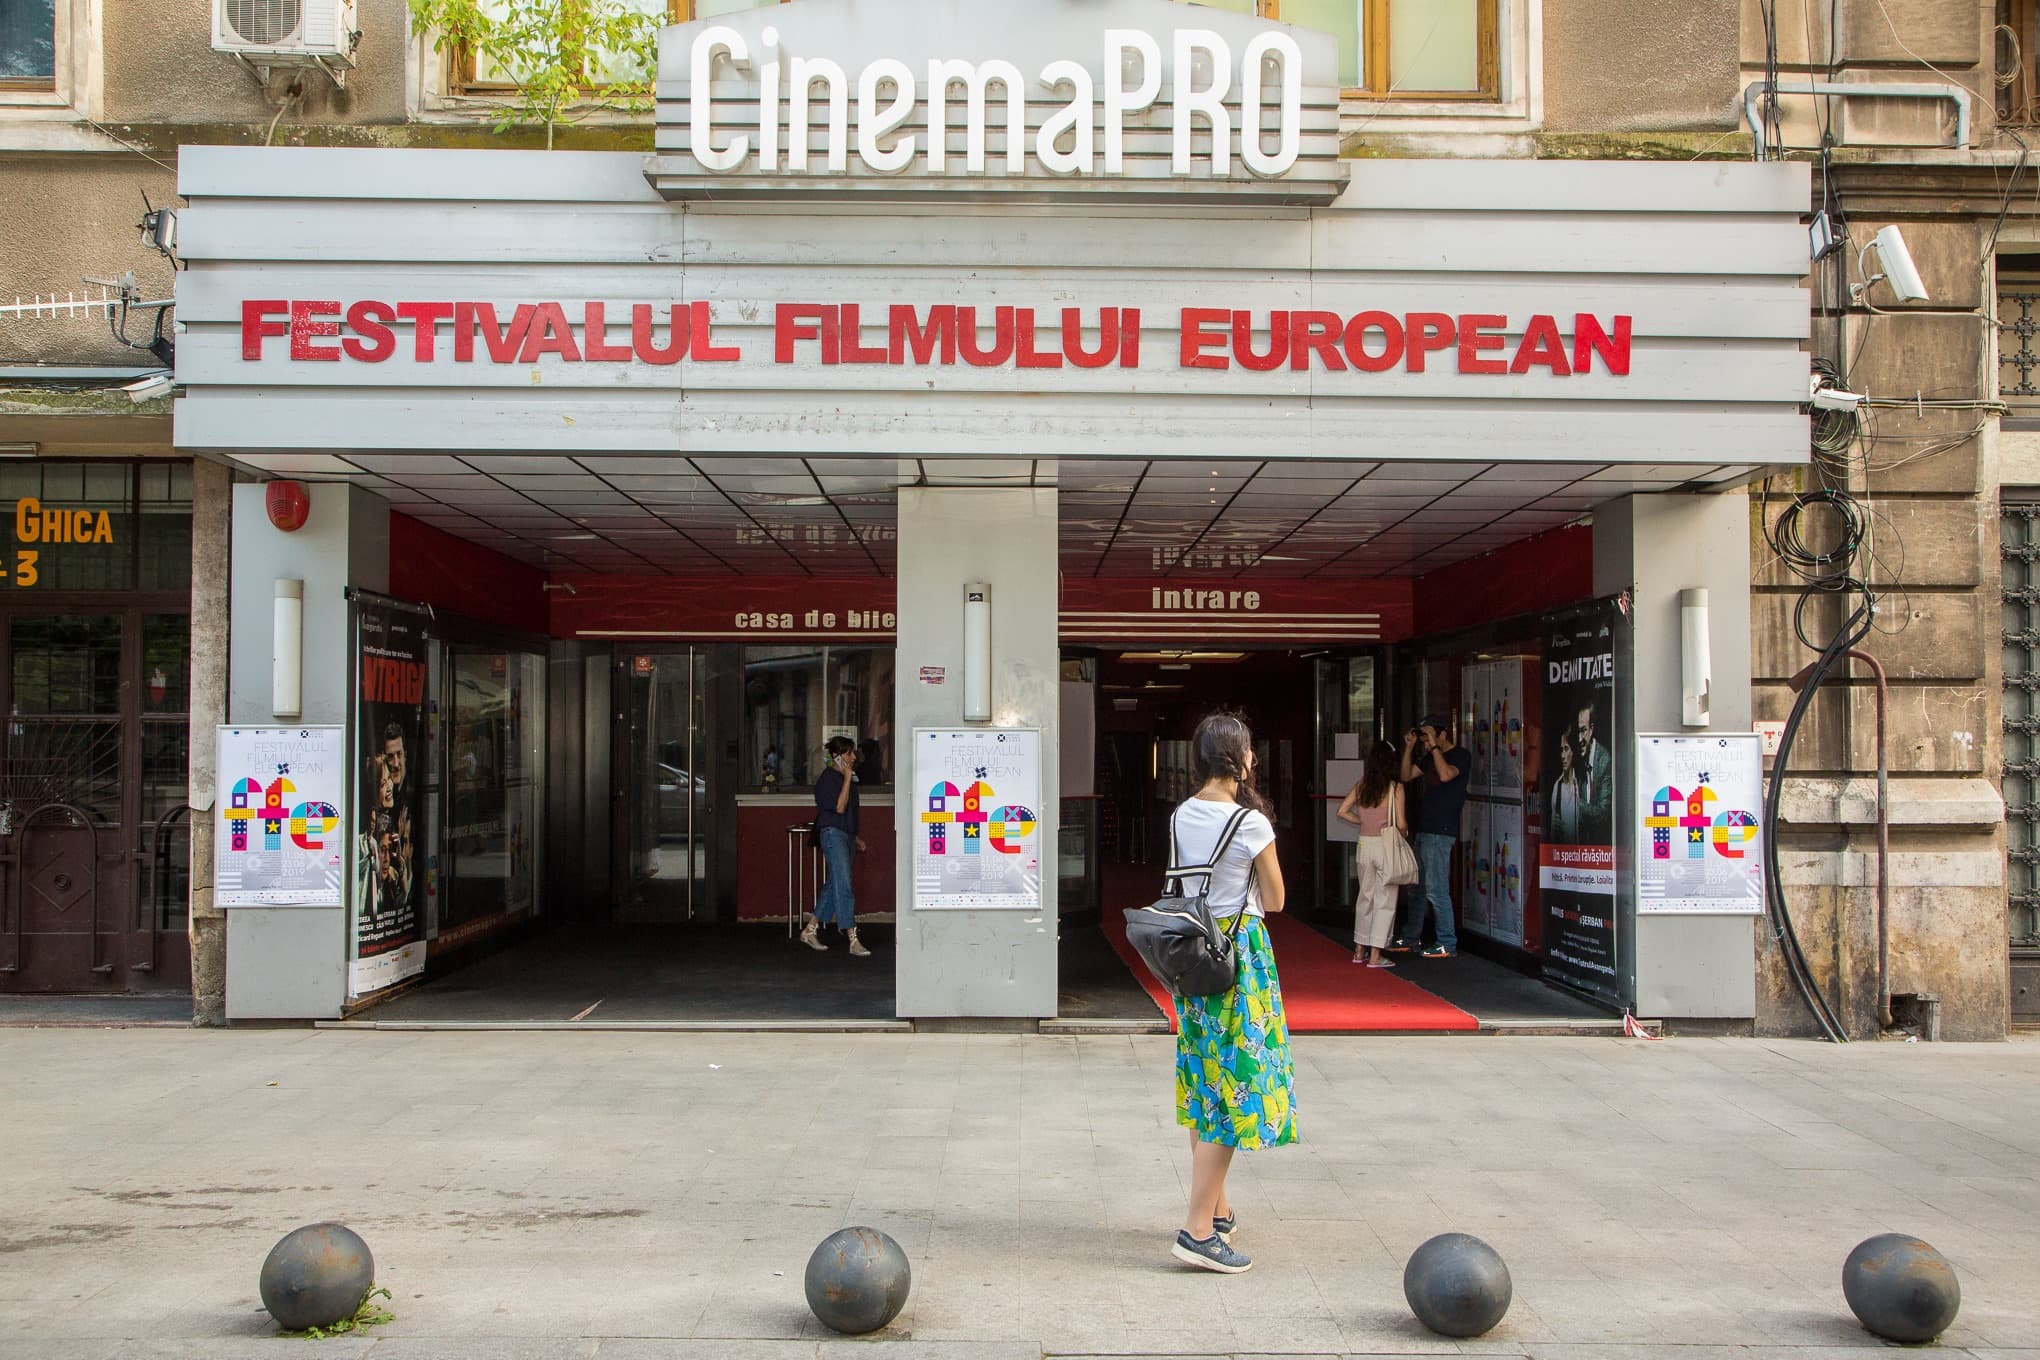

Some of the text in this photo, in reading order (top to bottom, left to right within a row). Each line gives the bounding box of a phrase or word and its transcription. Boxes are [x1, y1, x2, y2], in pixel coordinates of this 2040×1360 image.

[690, 25, 1302, 178] CinemaPRO
[241, 300, 1632, 376] FESTIVALUL FILMULUI EUROPEAN
[735, 612, 794, 628] casa
[804, 609, 836, 628] de
[254, 742, 328, 752] FESTIVALUL
[952, 745, 1024, 756] FESTIVALUL
[247, 752, 302, 763] FILMULUI
[944, 756, 1000, 767] FILMULUI
[281, 868, 305, 876] 2019
[981, 872, 1004, 880] 2019
